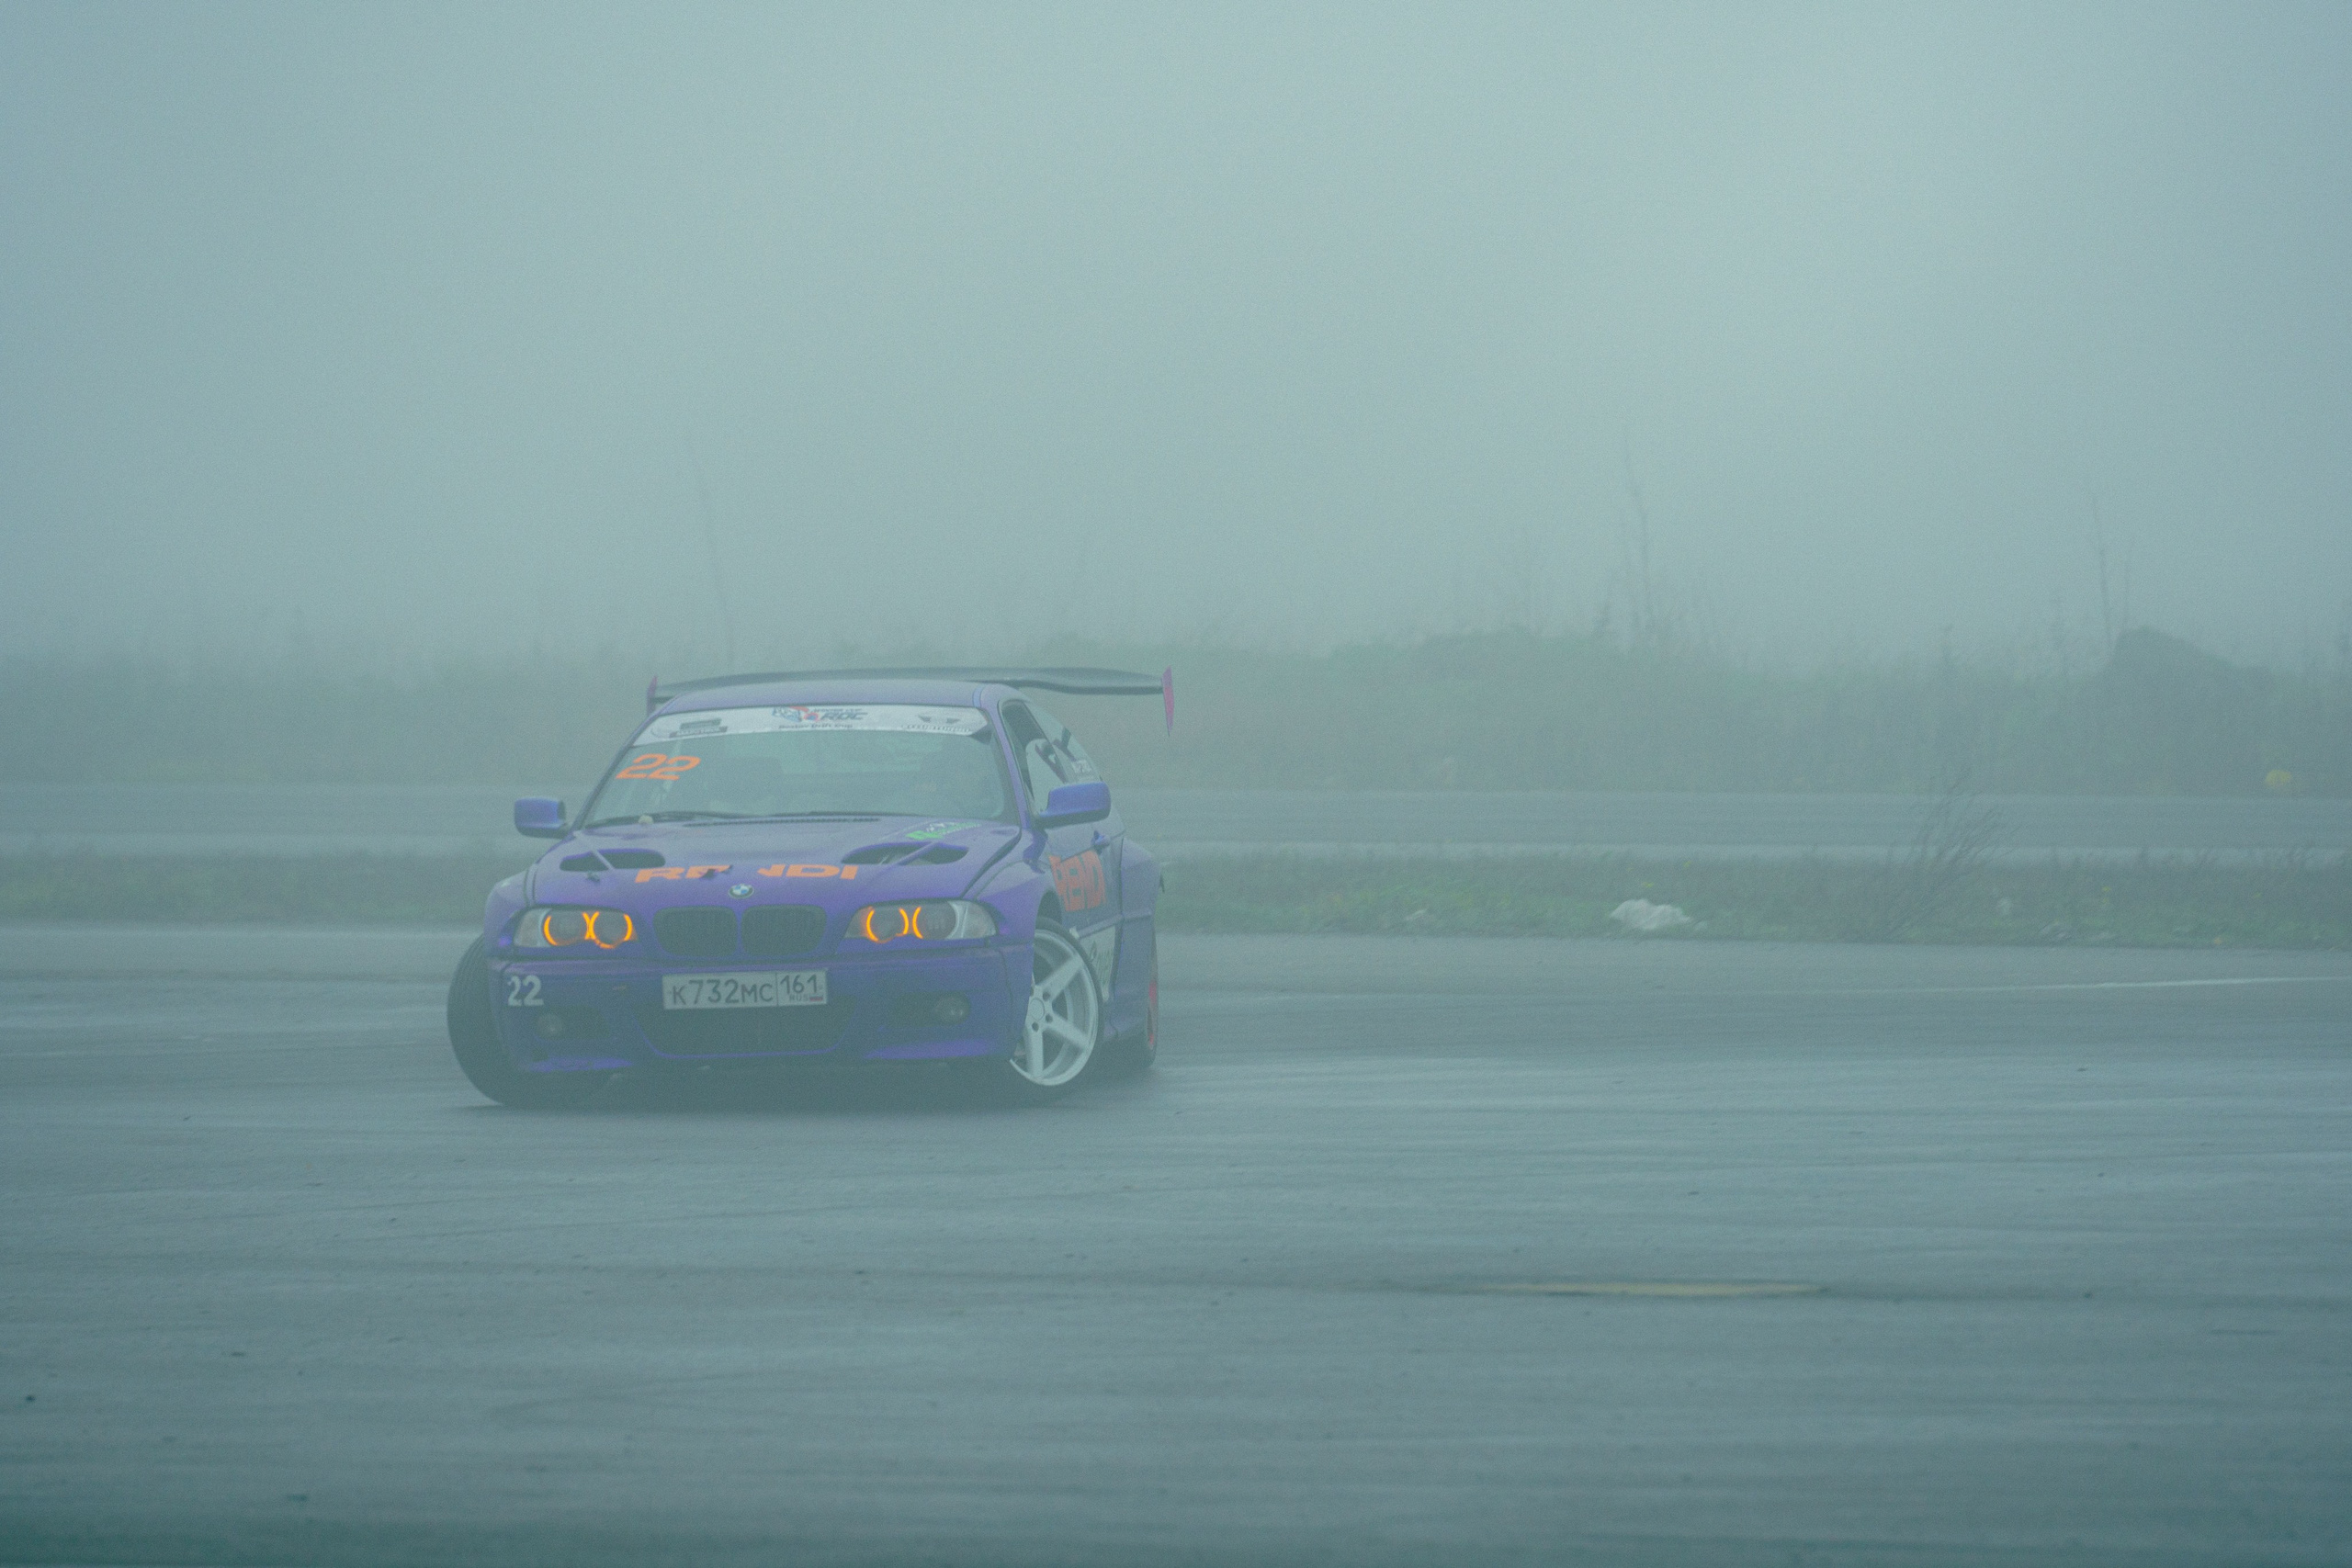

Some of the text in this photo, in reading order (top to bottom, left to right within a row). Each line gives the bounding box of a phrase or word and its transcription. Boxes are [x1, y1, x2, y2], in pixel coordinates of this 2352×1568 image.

[616, 753, 701, 781] 22
[506, 975, 544, 1007] 22
[672, 974, 819, 1005] К732МС 161
[788, 994, 809, 1002] RUS
